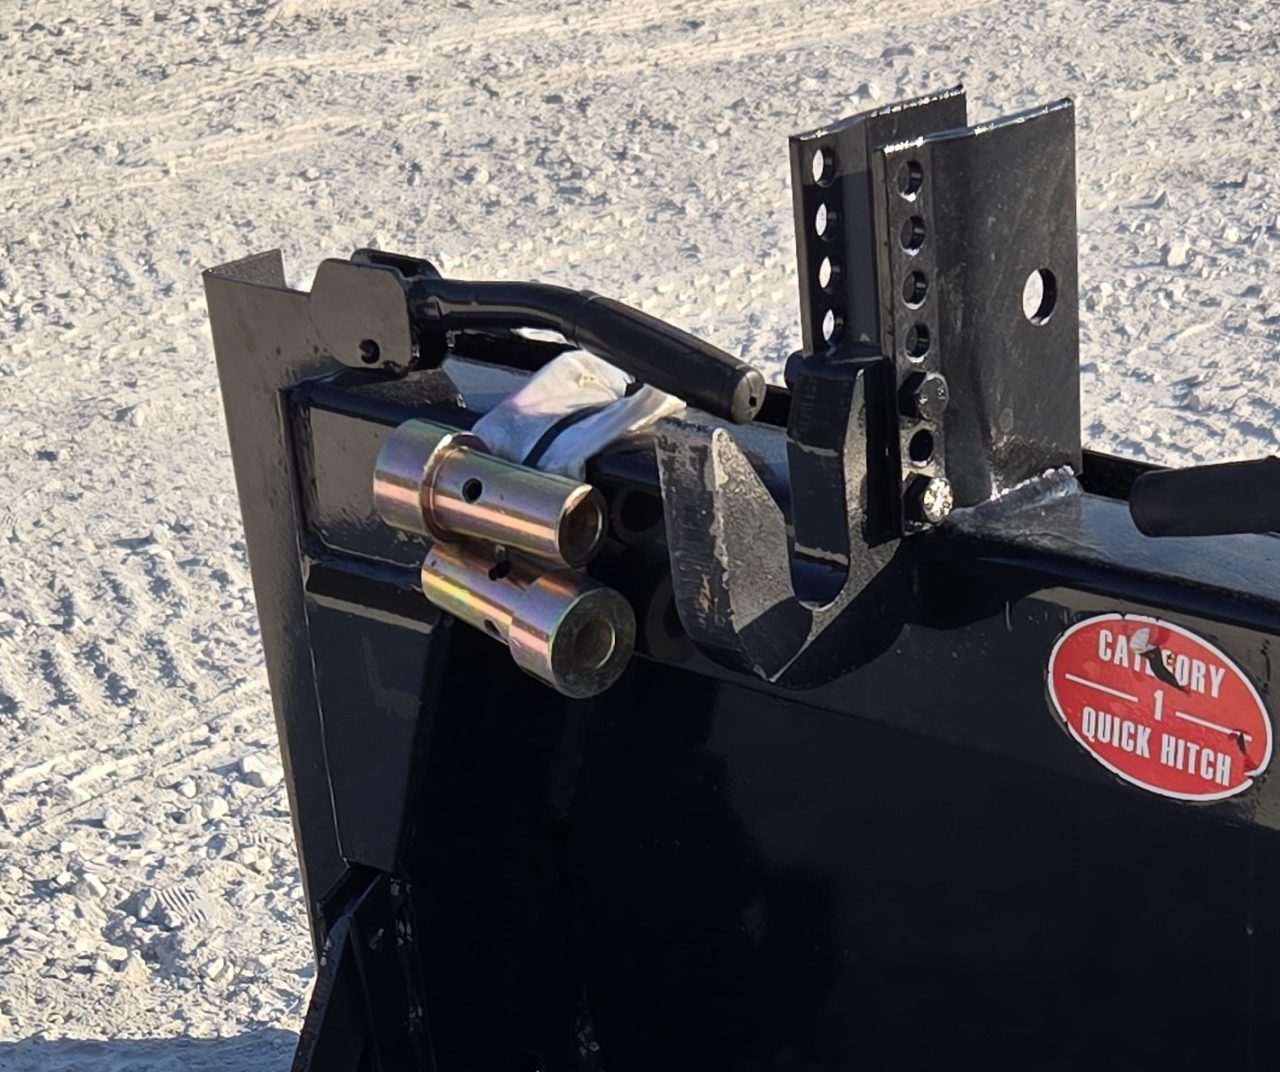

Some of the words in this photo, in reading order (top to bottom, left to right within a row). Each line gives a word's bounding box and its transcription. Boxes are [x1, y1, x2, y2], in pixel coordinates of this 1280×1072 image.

[1154, 689, 1164, 721] 1
[1081, 706, 1152, 758] QUICK
[1160, 733, 1232, 786] HITCH
